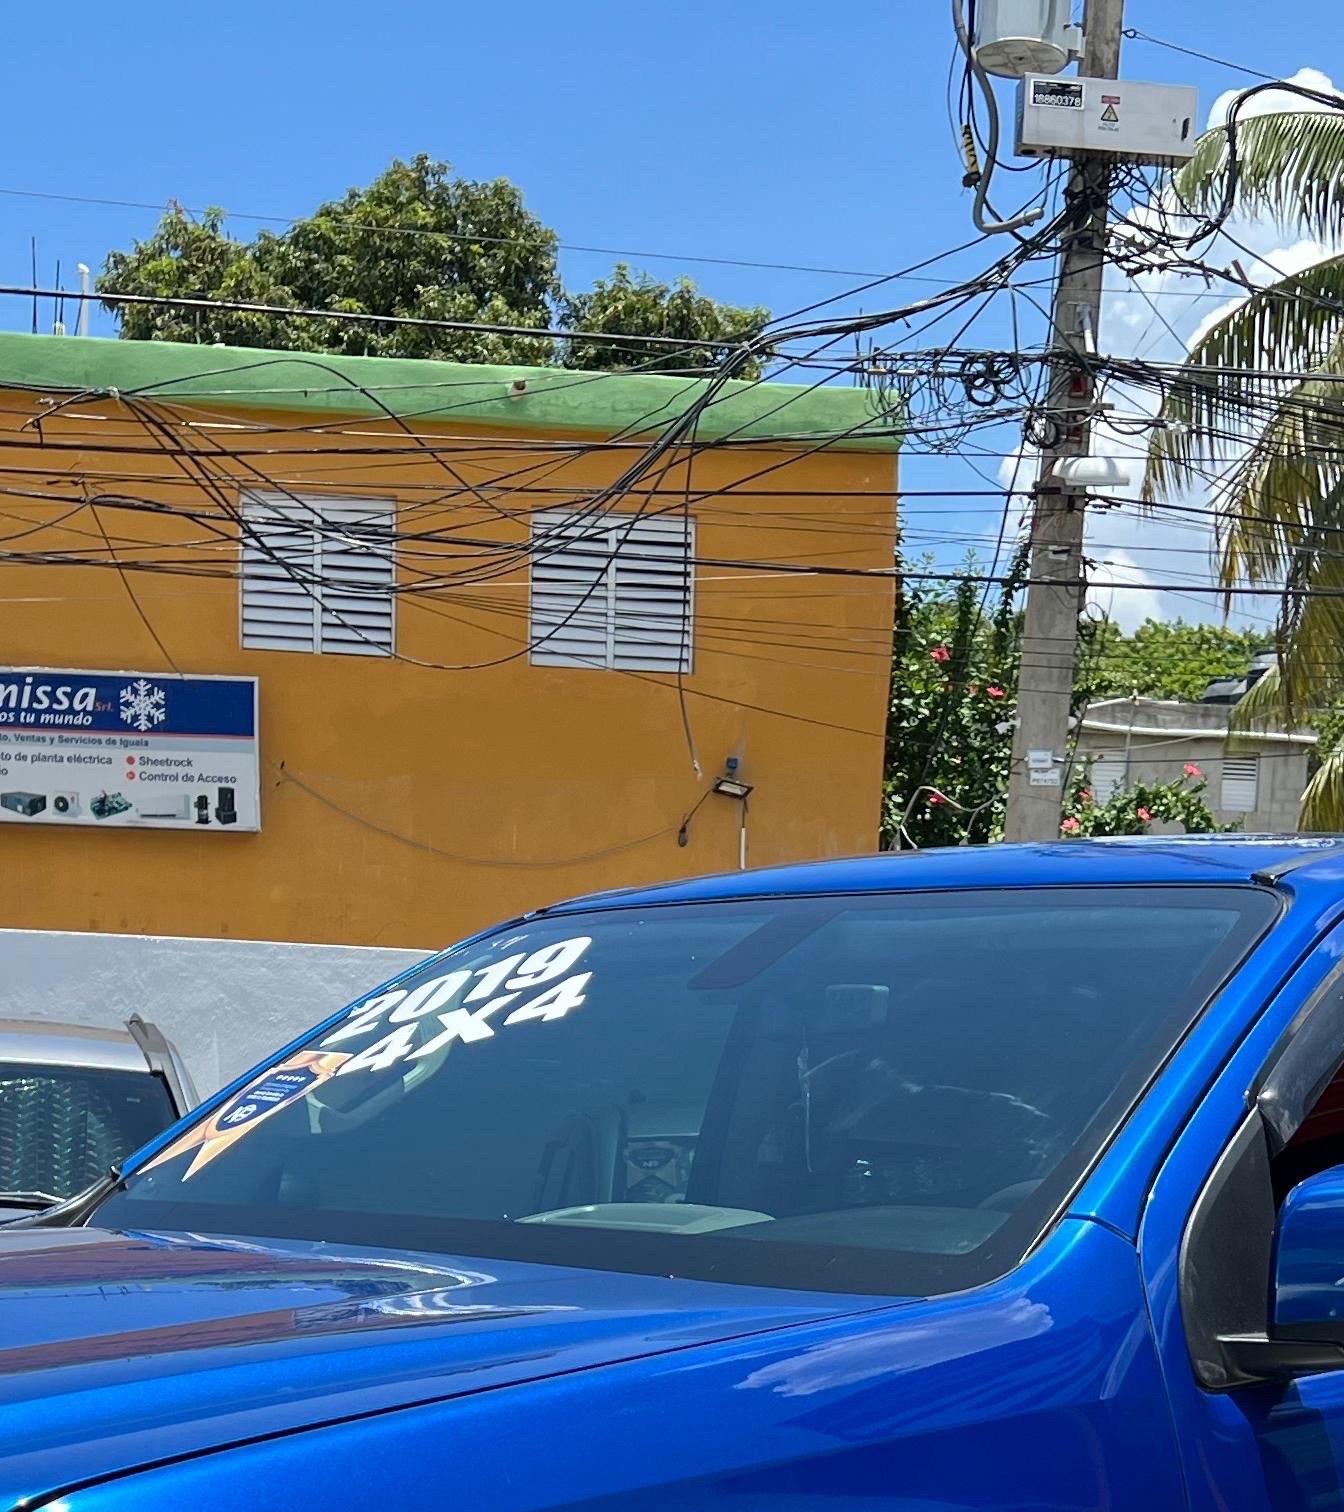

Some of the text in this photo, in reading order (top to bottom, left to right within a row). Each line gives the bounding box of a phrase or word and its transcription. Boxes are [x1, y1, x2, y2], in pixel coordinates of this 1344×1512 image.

[20, 710, 35, 723] tu
[40, 711, 93, 727] mundo
[14, 733, 47, 745] Ventas
[49, 737, 55, 746] y
[58, 735, 104, 746] Servicios
[106, 737, 118, 747] de
[14, 751, 28, 762] de
[31, 752, 64, 765] planta
[66, 753, 113, 765] eléctrica
[139, 755, 193, 768] Sheetrock
[139, 771, 236, 785] Control de Acceso
[320, 936, 592, 1048] 2019
